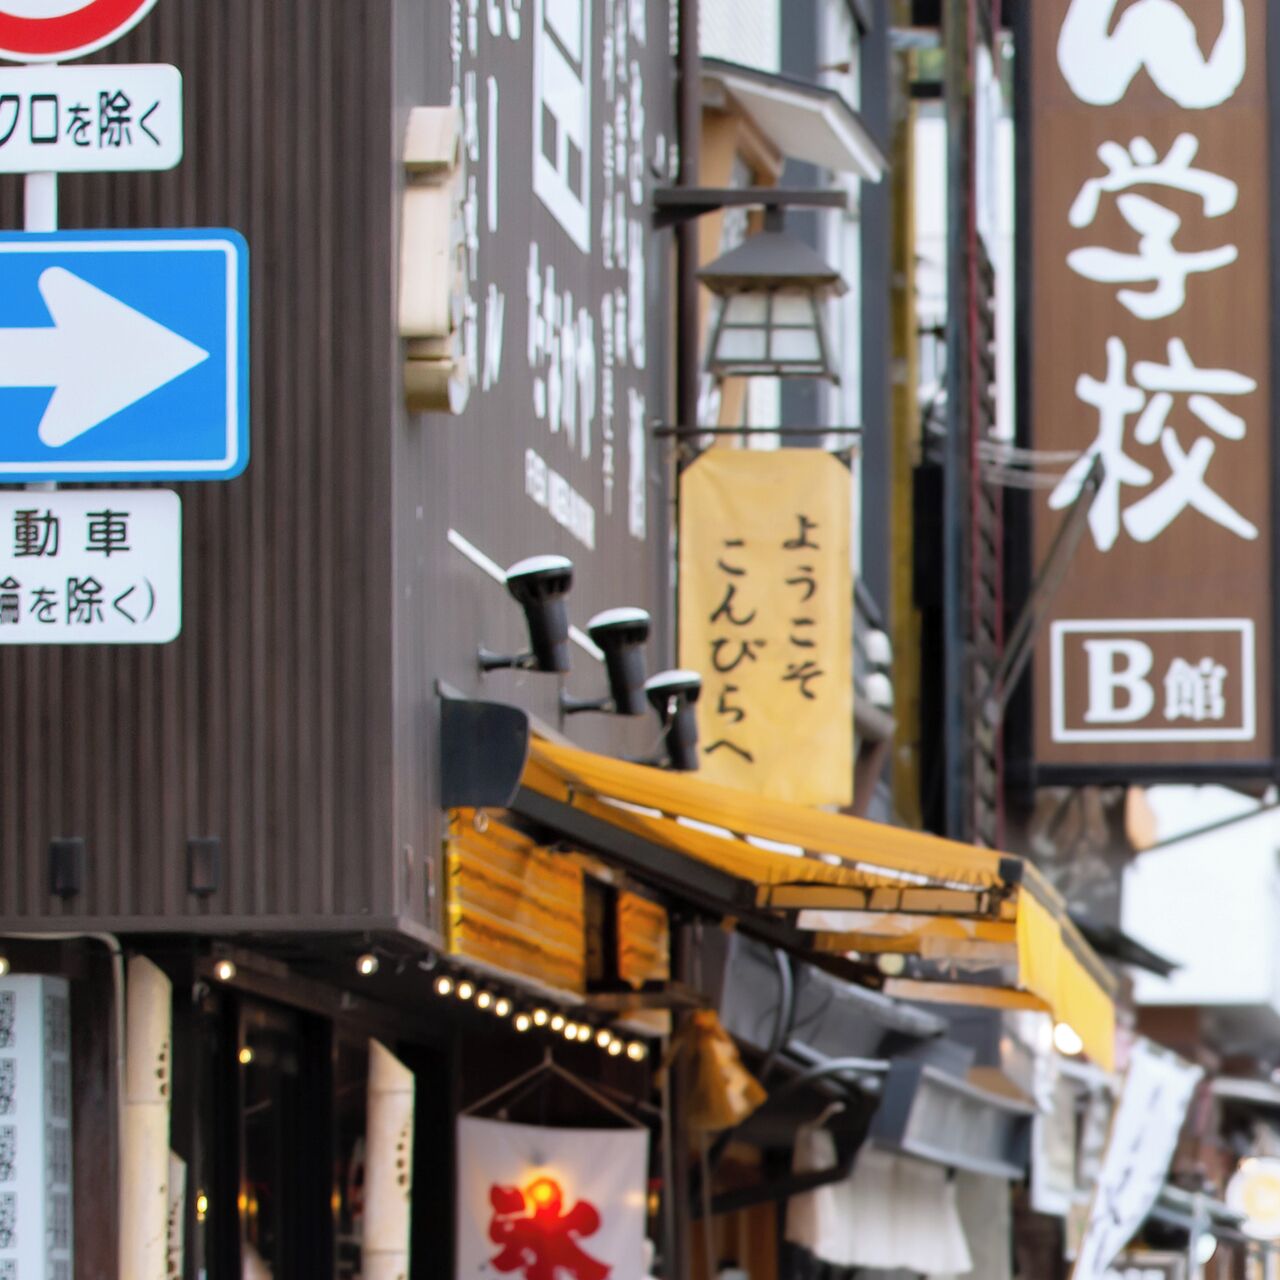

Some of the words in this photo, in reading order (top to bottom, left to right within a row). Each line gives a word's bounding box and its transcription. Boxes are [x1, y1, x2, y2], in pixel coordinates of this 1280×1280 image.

[14, 509, 131, 557] 動車
[782, 513, 824, 701] ようこそ
[1083, 638, 1228, 722] B館
